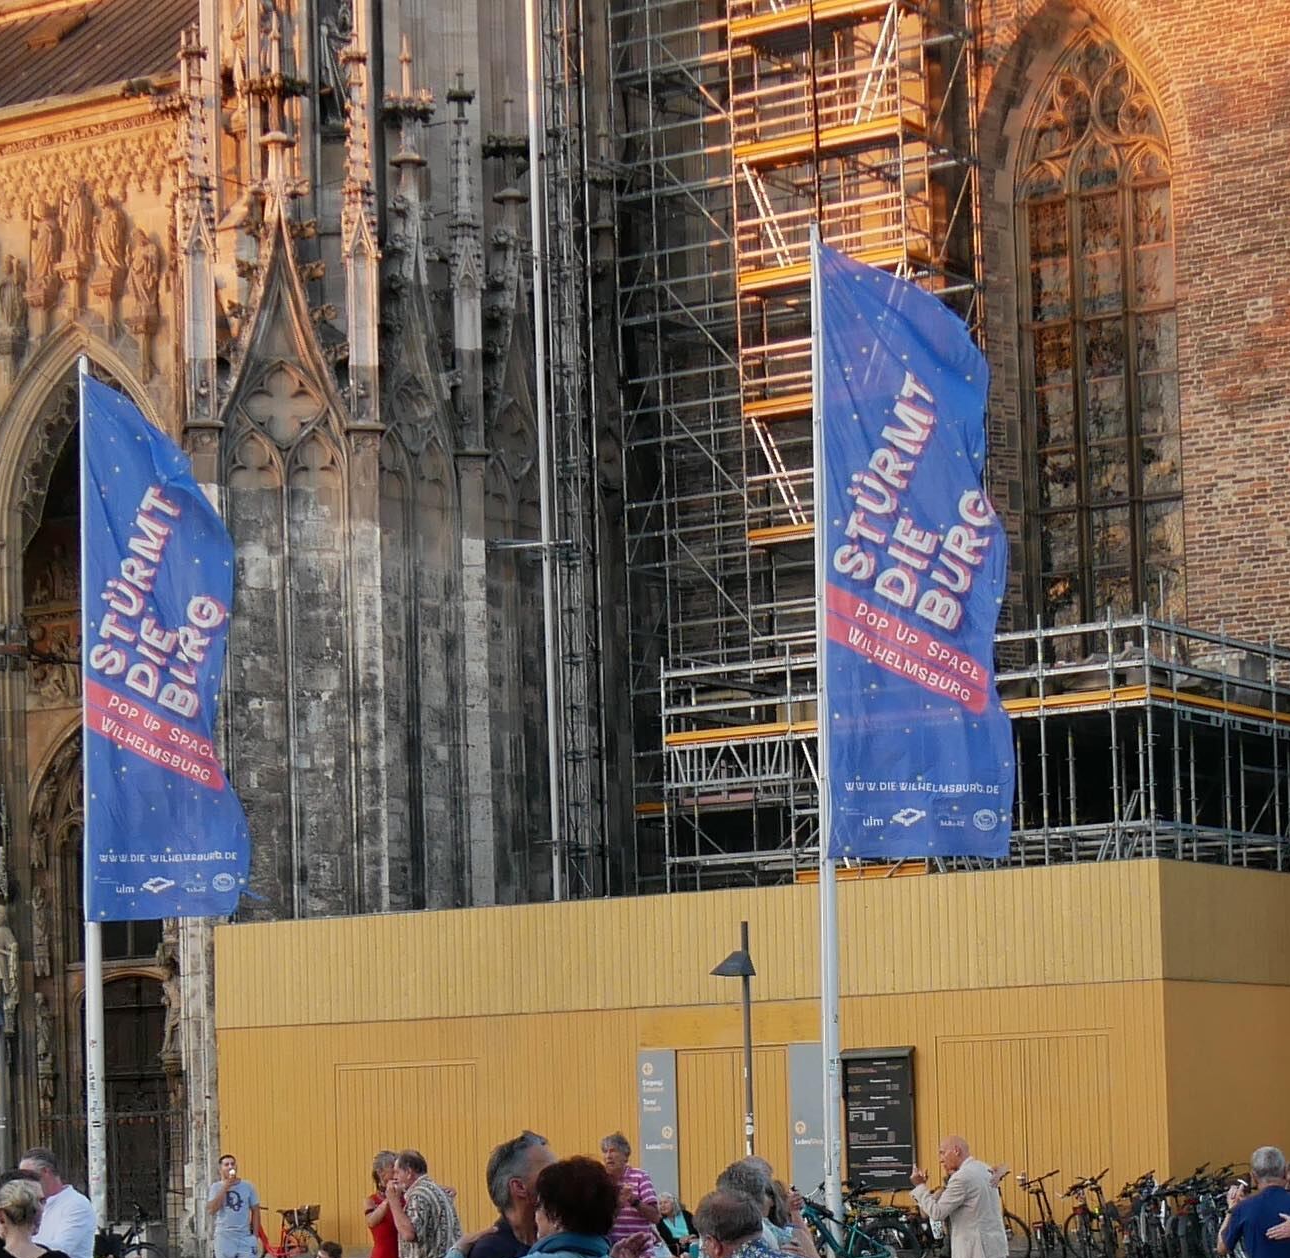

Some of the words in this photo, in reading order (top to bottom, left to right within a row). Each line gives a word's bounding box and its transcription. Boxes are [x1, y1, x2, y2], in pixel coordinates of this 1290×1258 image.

[833, 371, 935, 580] STÜRMT
[89, 486, 180, 676] STÜRMT
[874, 517, 938, 608] DIE
[125, 617, 177, 699] DIE
[855, 603, 889, 630] POP
[896, 625, 918, 645] UP
[848, 626, 971, 702] WILHELMSBURG
[101, 716, 211, 781] WILHELMSBURG
[108, 696, 139, 718] POP
[143, 715, 161, 732] UP
[863, 816, 884, 827] ulm
[116, 884, 135, 894] ulm
